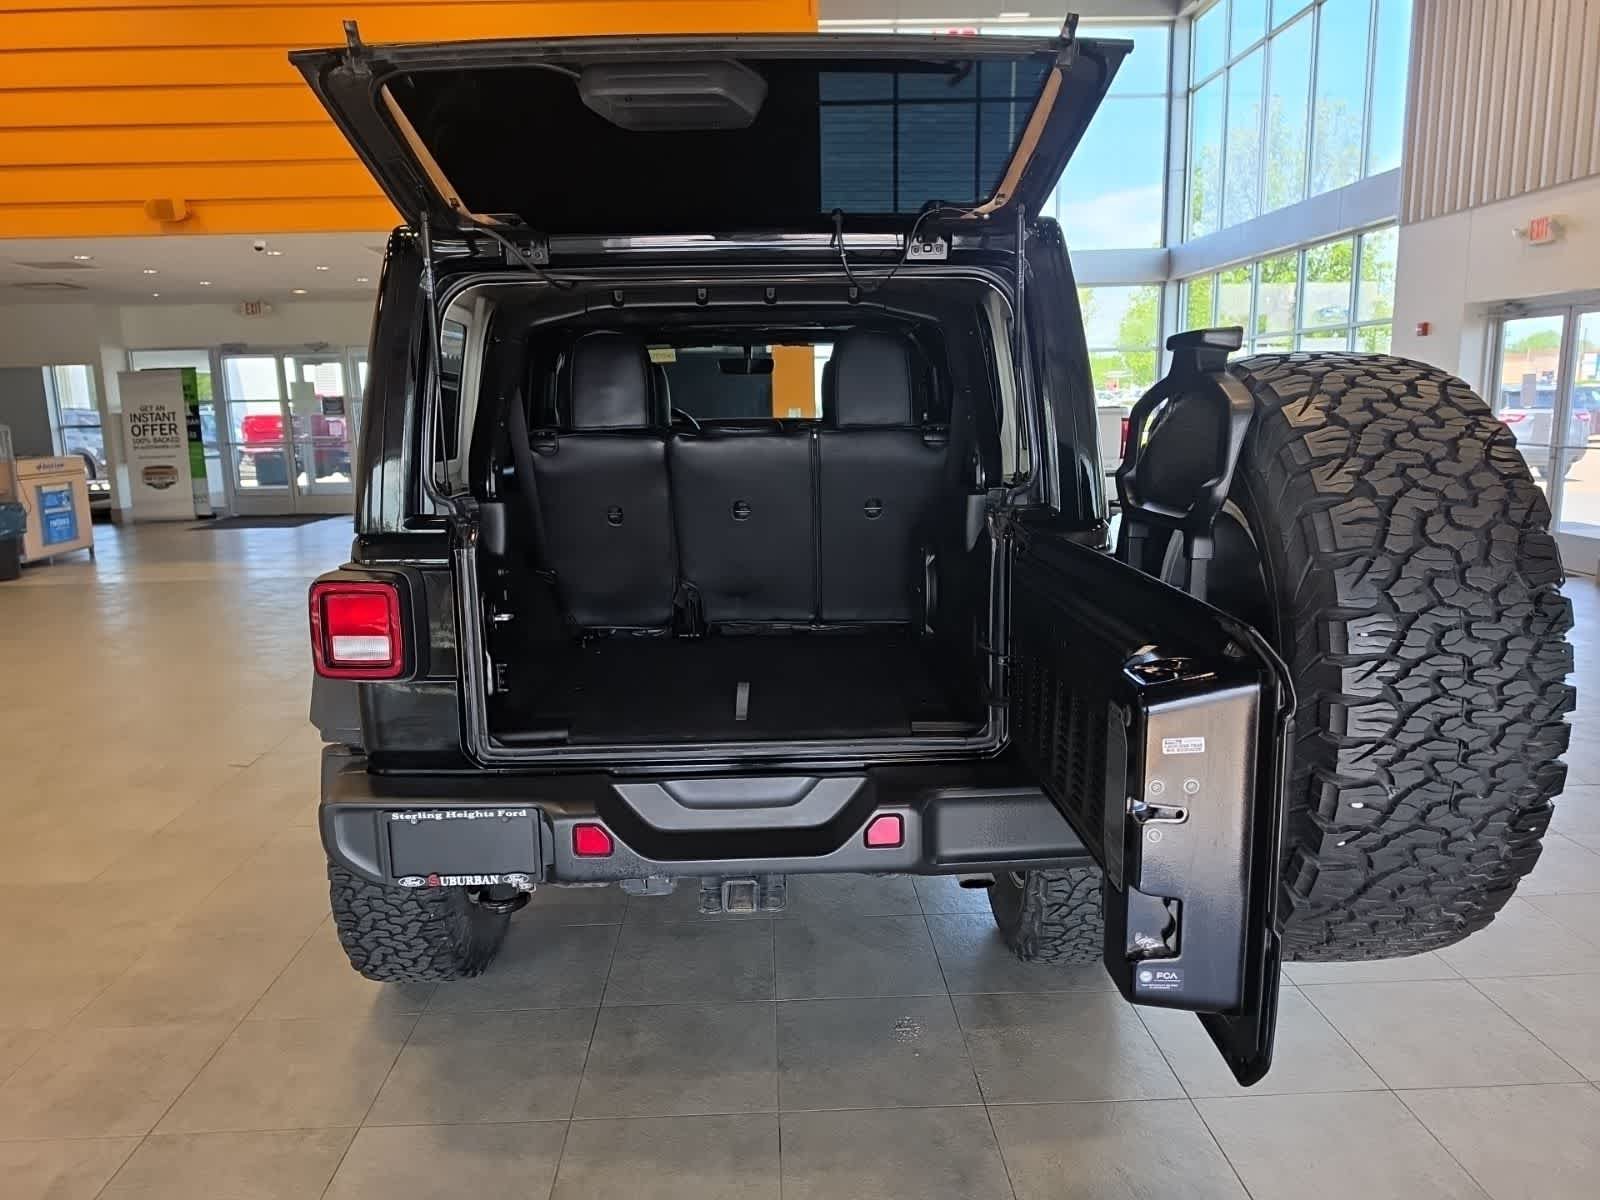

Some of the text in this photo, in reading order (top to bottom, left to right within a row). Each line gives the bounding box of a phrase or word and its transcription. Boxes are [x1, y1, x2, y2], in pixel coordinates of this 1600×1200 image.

[1530, 217, 1550, 241] EXIT
[245, 302, 262, 315] EXIT
[129, 411, 176, 423] INSTANT
[130, 423, 178, 437] OFFER
[391, 809, 528, 821] Sterling Heights Ford
[428, 874, 499, 888] SUBURBAN
